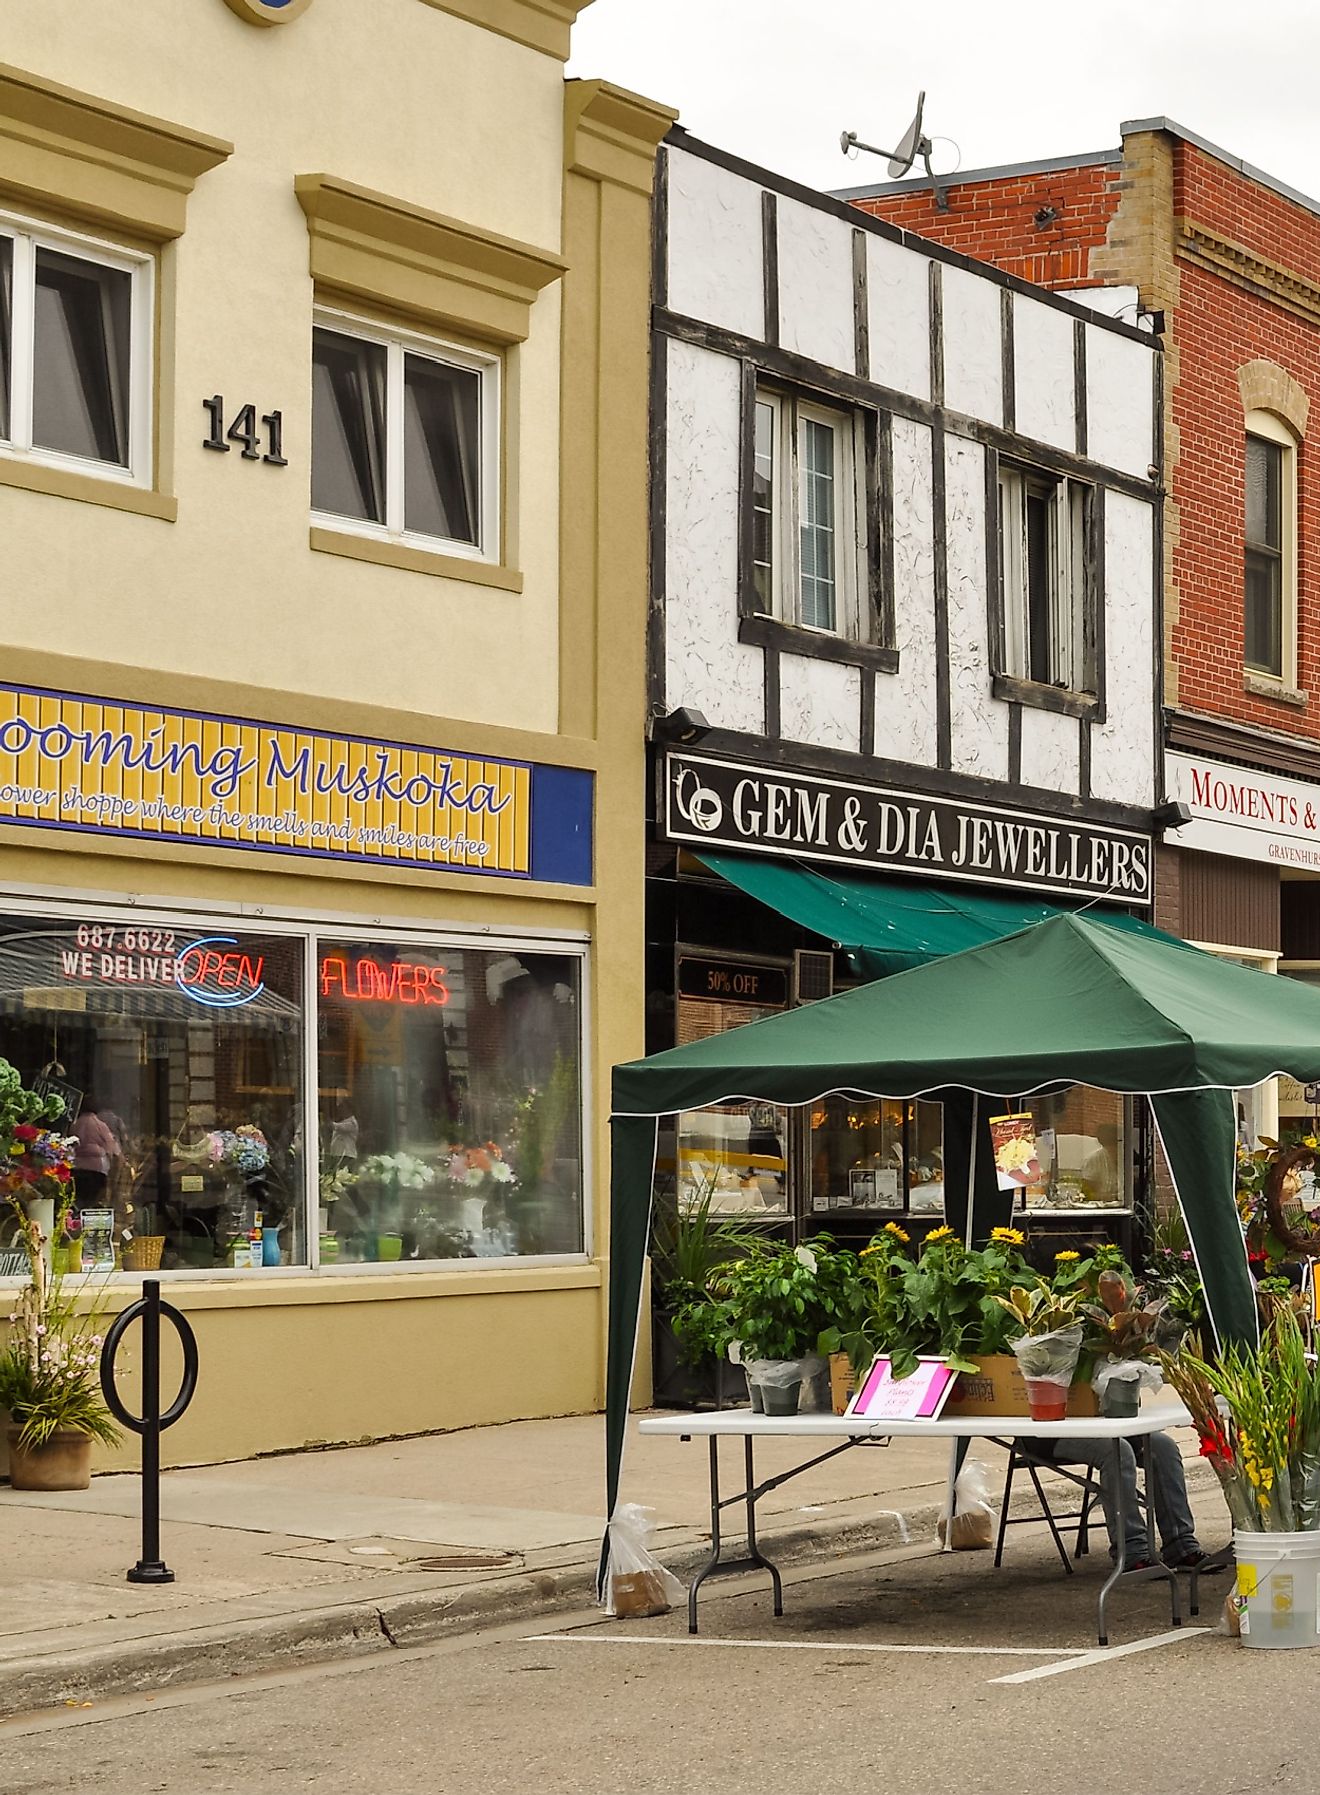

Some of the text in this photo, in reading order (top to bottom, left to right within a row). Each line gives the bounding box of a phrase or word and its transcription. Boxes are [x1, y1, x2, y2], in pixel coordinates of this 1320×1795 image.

[203, 395, 288, 466] 141
[266, 739, 512, 813] Muskoka
[1190, 768, 1298, 826] MOMENTS
[1304, 802, 1317, 830] &
[62, 786, 138, 820] shoppe
[142, 797, 206, 823] where
[209, 803, 244, 826] the
[247, 812, 308, 835] smells
[311, 819, 354, 840] and
[357, 824, 415, 849] smiles
[419, 835, 451, 850] are
[453, 834, 489, 856] free
[733, 778, 1147, 893] GEM & DIA JEWELLERS
[77, 924, 176, 954] 687.6622
[62, 951, 186, 982] WE DELIVER
[182, 947, 264, 988] OPEN
[322, 958, 449, 1004] FLOWERS
[708, 970, 758, 994] 50% OFF
